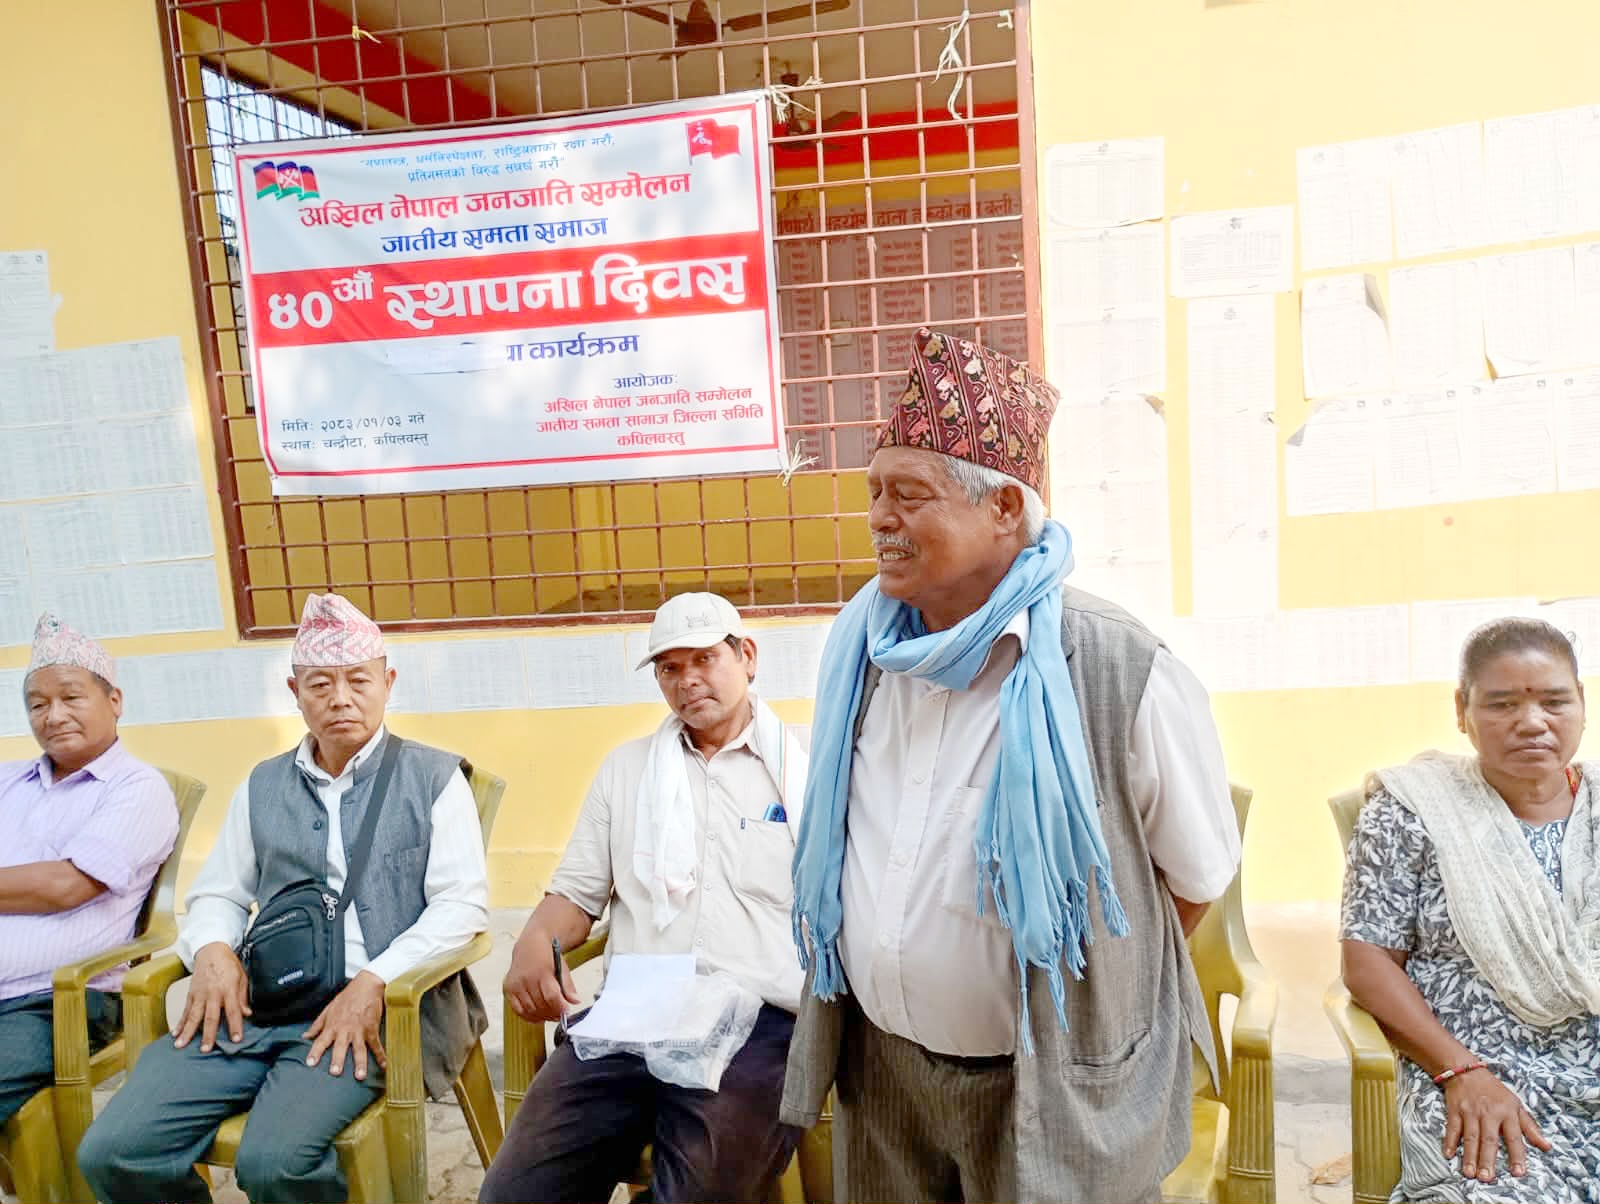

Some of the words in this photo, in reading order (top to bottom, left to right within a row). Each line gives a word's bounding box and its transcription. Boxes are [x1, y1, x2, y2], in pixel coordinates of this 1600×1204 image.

[298, 199, 384, 228] अखिल
[390, 193, 459, 219] नेपाल
[464, 179, 575, 213] जनजाति
[580, 171, 691, 206] सम्मेलन
[381, 227, 458, 253] जातीय
[463, 223, 528, 250] समता
[534, 217, 609, 244] समाज
[383, 271, 583, 330] स्थापना
[591, 253, 748, 313] दिवस
[527, 332, 640, 361] कार्यक्रम
[544, 397, 588, 413] अखिल
[593, 394, 631, 410] नेपाल
[636, 389, 690, 408] जनजाति
[695, 386, 752, 403] सम्मेलन
[536, 416, 579, 433] जातीय
[583, 415, 619, 431] समता
[674, 408, 717, 424] जिल्ला
[722, 404, 764, 421] समिति
[373, 432, 430, 447] कपिलवस्तु
[617, 430, 686, 447] कपिलवस्तु
